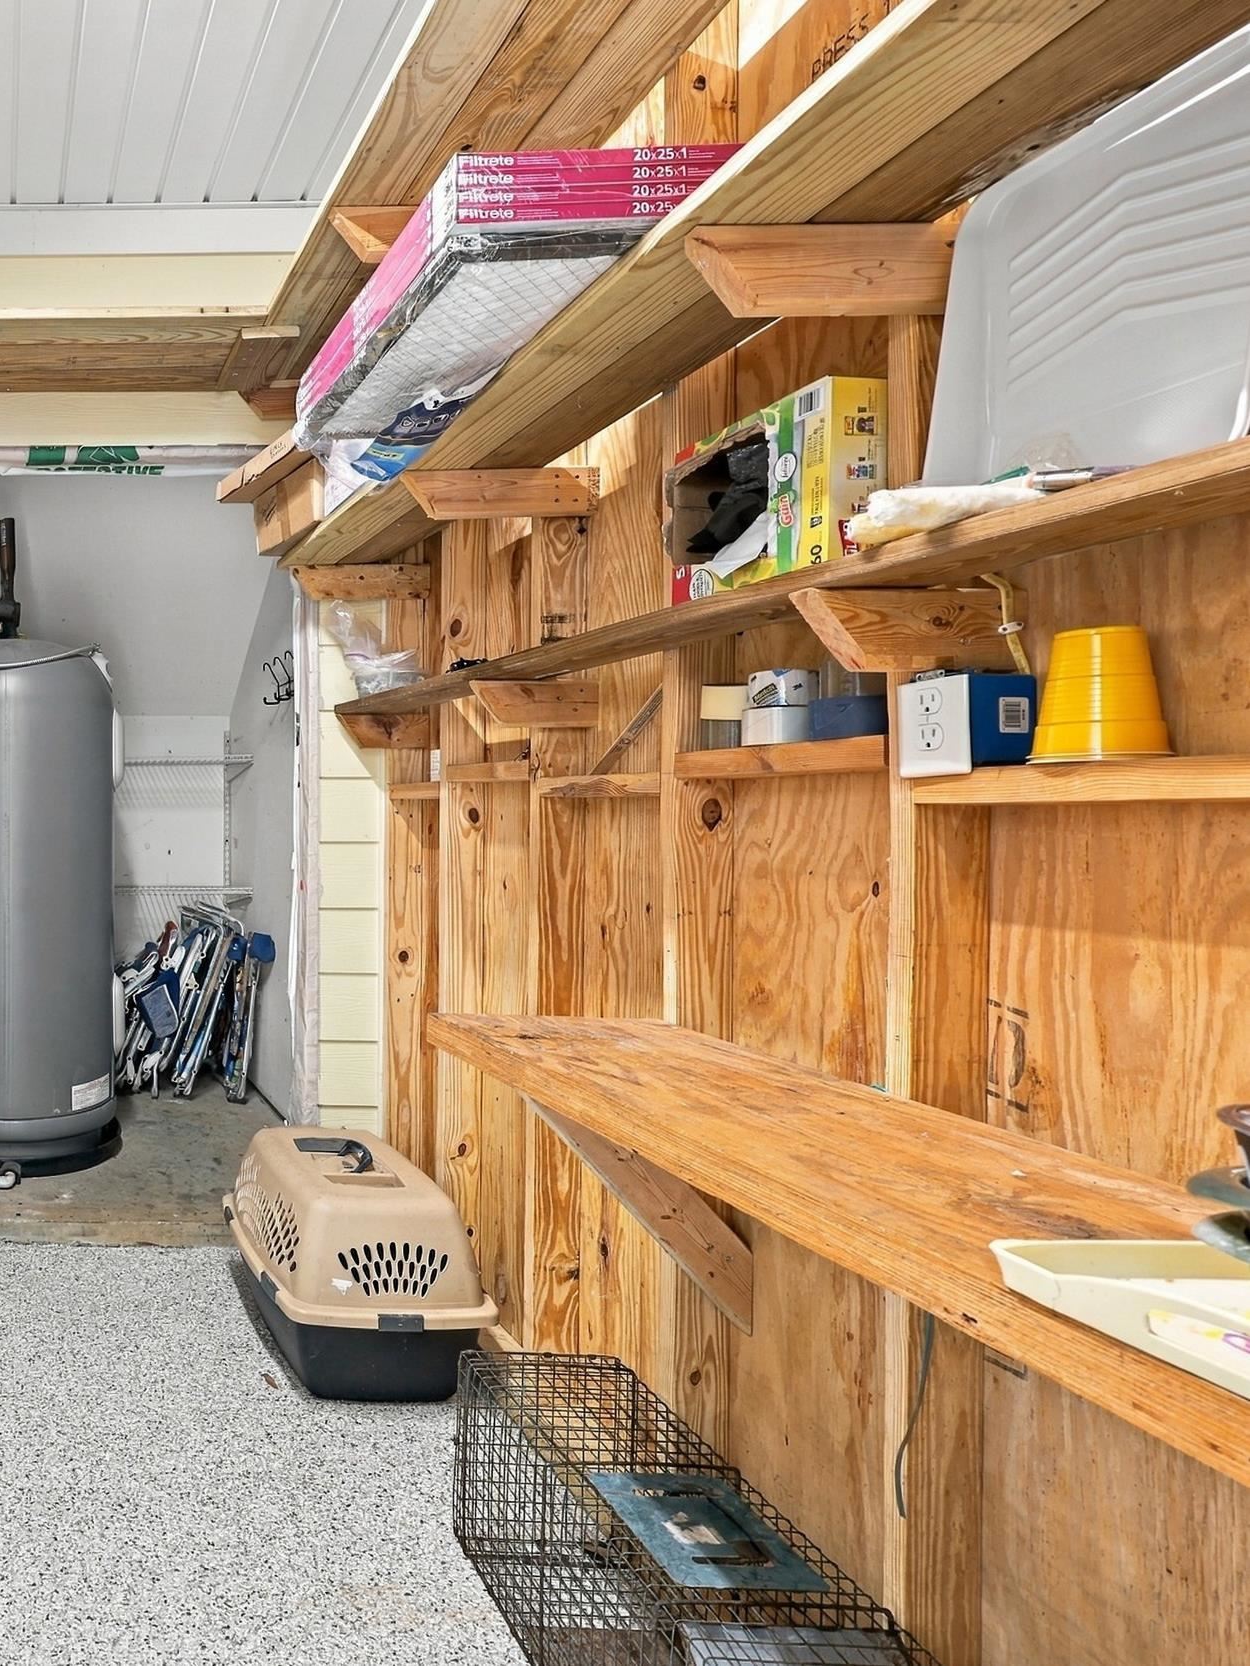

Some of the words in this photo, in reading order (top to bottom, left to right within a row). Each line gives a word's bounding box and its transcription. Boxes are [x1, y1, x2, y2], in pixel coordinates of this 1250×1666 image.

[459, 156, 515, 168] Filtrete
[633, 147, 688, 161] 20x25x1
[458, 173, 514, 186] Filtrete
[632, 165, 687, 179] 20x25x1
[632, 184, 687, 197] 20x25x1
[458, 207, 514, 220] Filtrete
[779, 494, 794, 526] Gain
